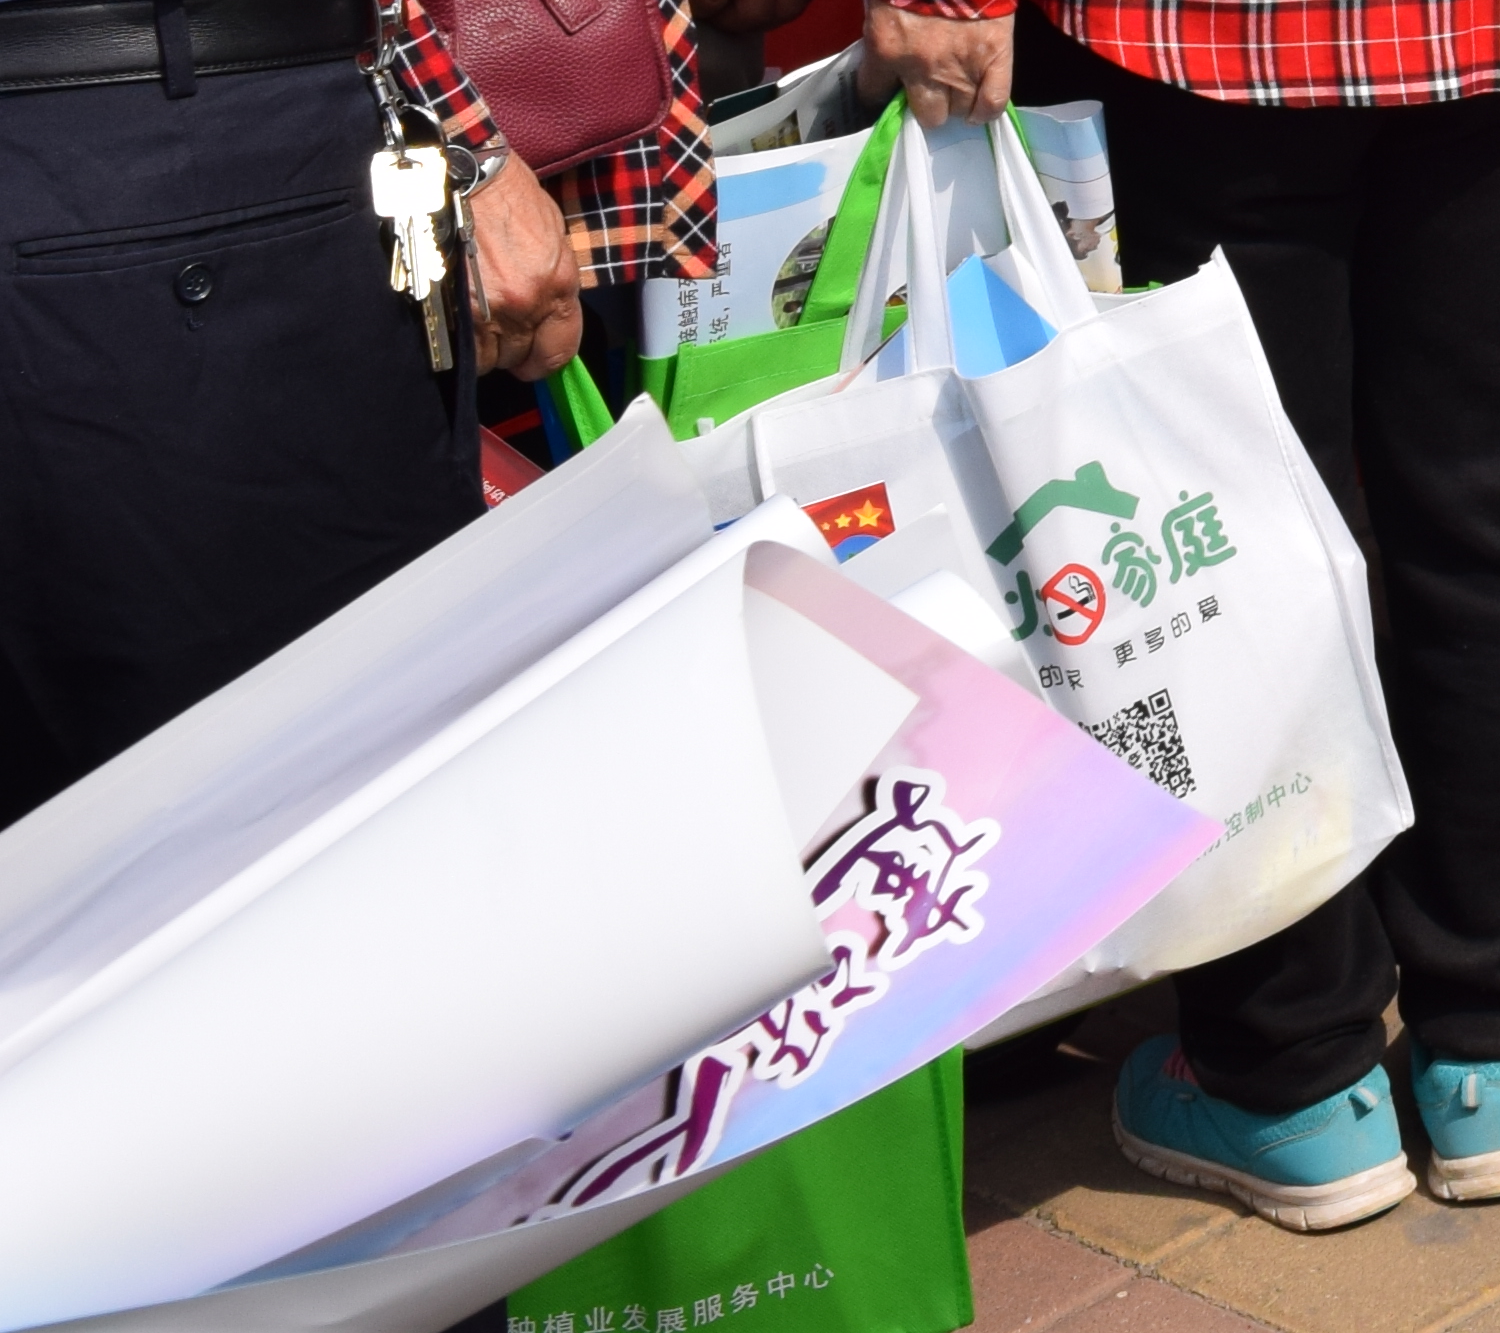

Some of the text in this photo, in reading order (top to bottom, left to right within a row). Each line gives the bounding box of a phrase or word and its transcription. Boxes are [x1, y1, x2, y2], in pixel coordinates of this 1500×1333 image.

[1112, 595, 1222, 668] 更多的爱
[507, 1263, 836, 1333] 种植业发展服务中心
